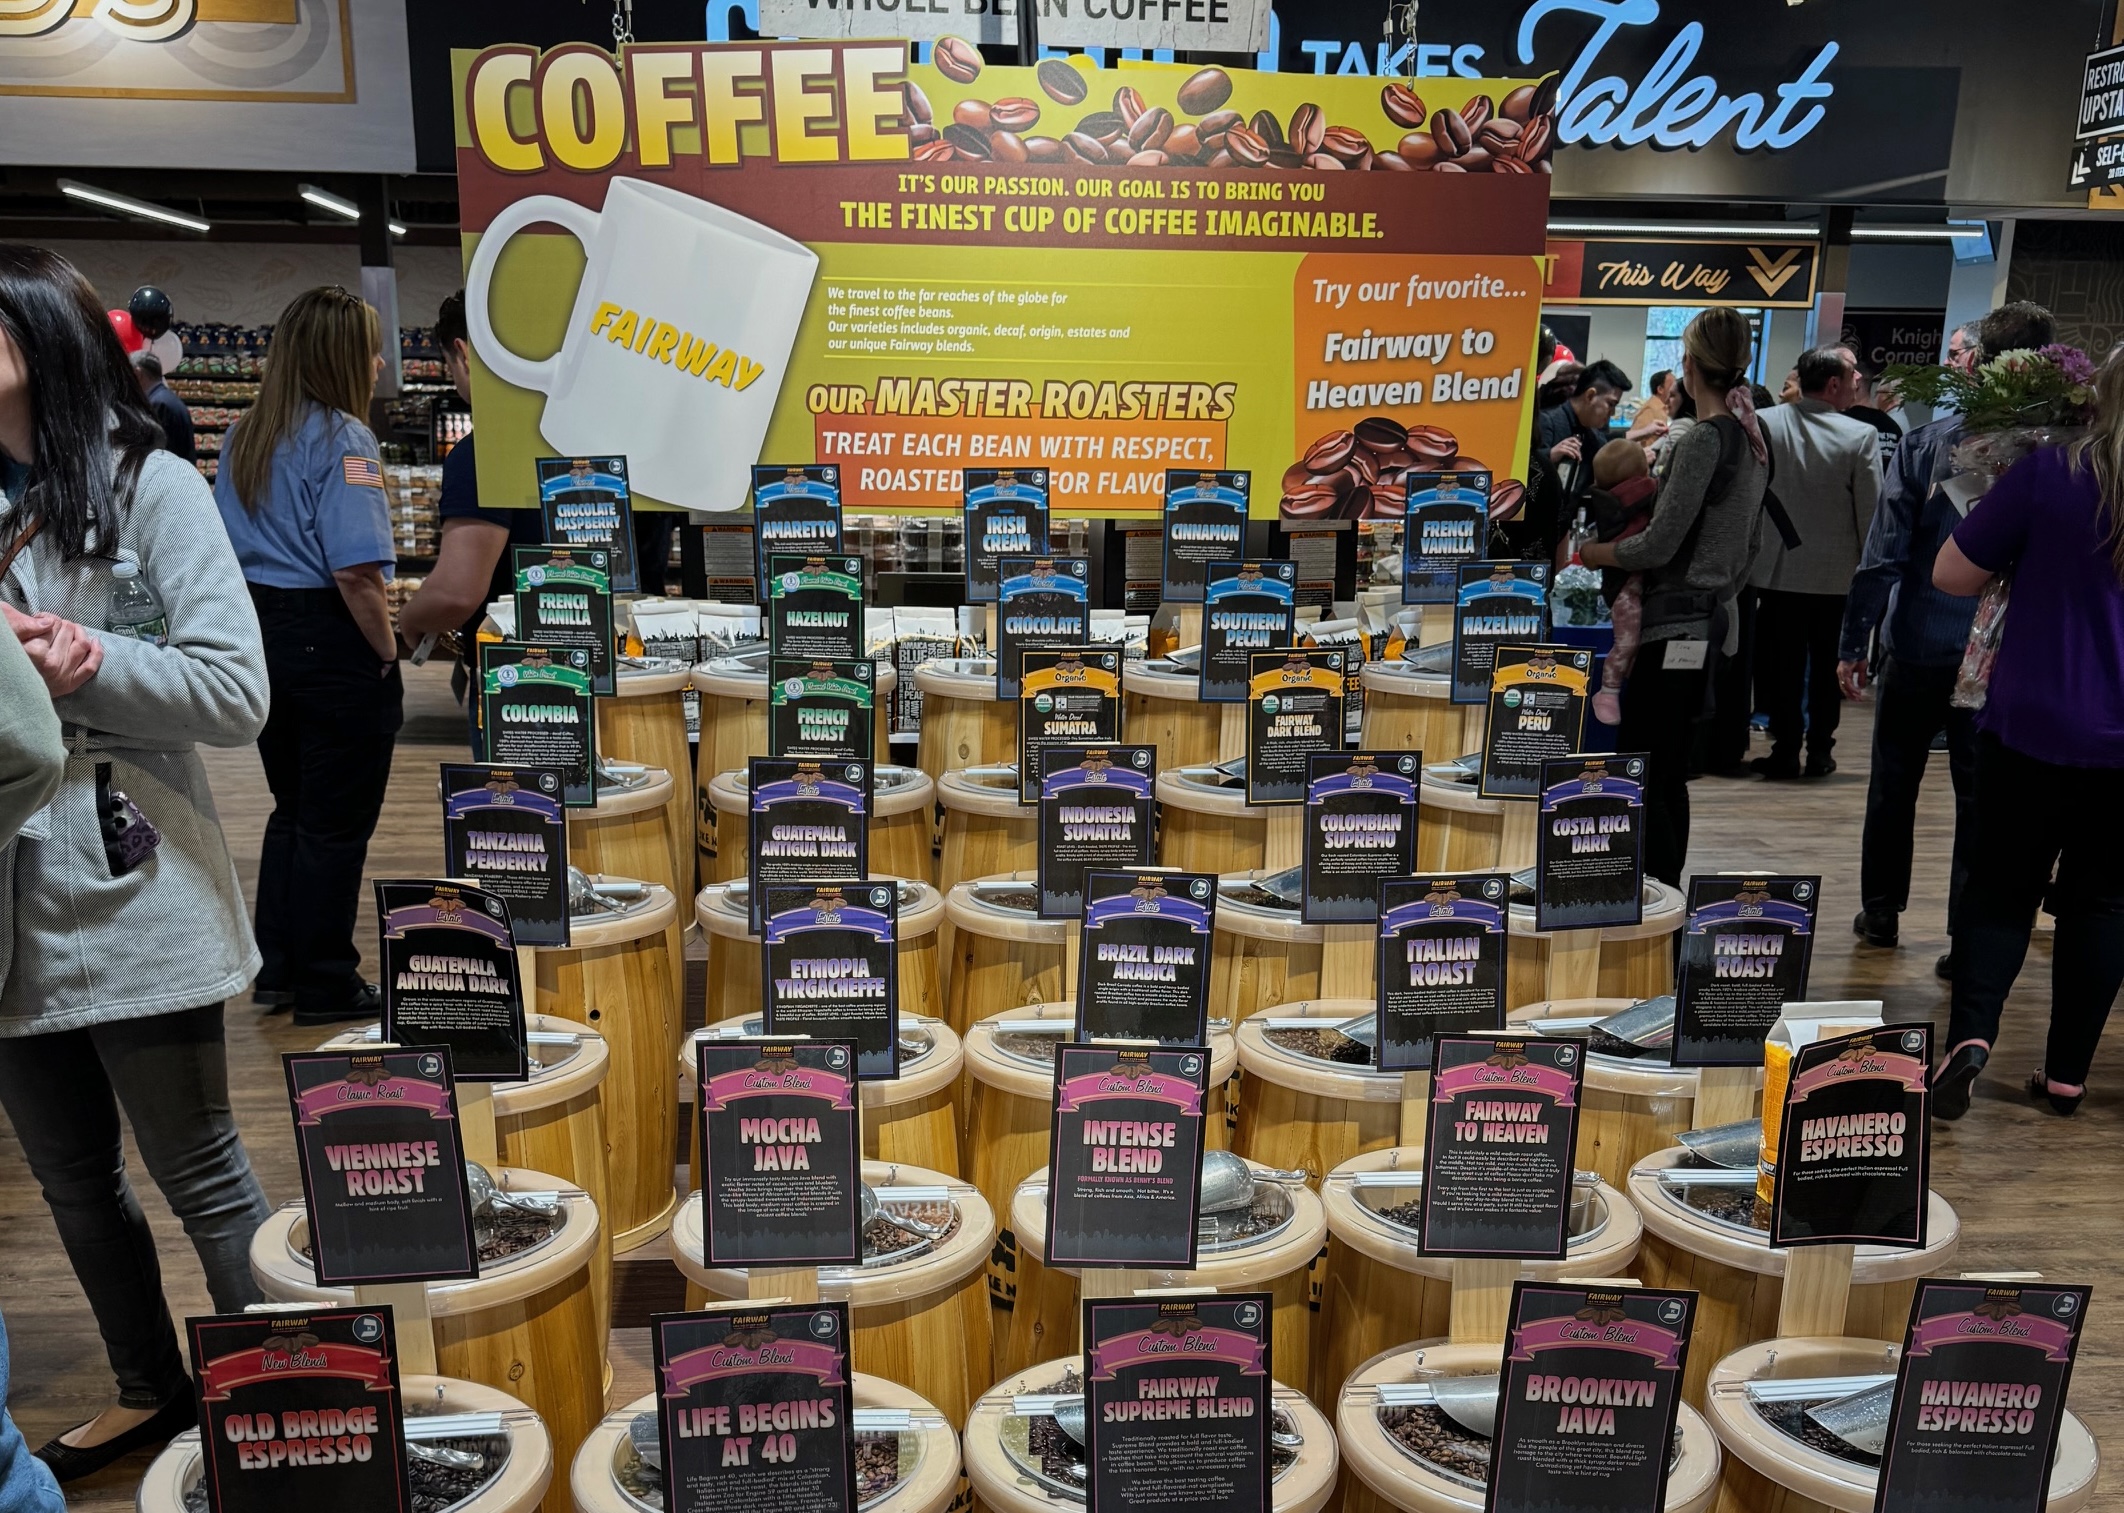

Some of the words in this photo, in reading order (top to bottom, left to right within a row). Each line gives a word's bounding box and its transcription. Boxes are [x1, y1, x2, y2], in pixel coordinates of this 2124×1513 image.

[1301, 40, 1485, 79] TAKES
[1517, 0, 1839, 149] Talent
[473, 47, 910, 171] COFFEE
[899, 174, 935, 193] IT'S
[941, 175, 978, 194] OUR
[985, 177, 1069, 196] PASSION.
[1075, 179, 1112, 197] OUR
[1118, 180, 1165, 199] GOAL
[1170, 181, 1190, 199] IS
[1196, 181, 1219, 200] TO
[1225, 182, 1282, 201] BRING
[1288, 183, 1325, 202] YOU
[840, 201, 892, 228] THE
[901, 203, 996, 230] FINEST
[1004, 205, 1054, 232] CUP
[1063, 207, 1096, 233] OF
[1104, 207, 1197, 236] COFFEE
[1205, 210, 1385, 239] IMAGINABLE.
[1598, 260, 1655, 290] This
[1660, 262, 1732, 294] Way
[828, 287, 844, 299] We
[848, 288, 880, 299] travel
[884, 289, 895, 299] to
[898, 289, 916, 300] the
[918, 289, 936, 303] far
[938, 290, 980, 302] reaches
[983, 291, 995, 305] of
[997, 291, 1015, 303] the
[1018, 292, 1048, 306] globe
[1051, 292, 1068, 306] for
[1313, 279, 1351, 309] Try
[1358, 282, 1400, 302] our
[1406, 274, 1527, 307] favorite...
[828, 304, 846, 315] the
[849, 304, 879, 318] finest
[882, 306, 916, 319] coffee
[919, 306, 954, 318] beans.
[828, 321, 848, 332] Our
[851, 322, 898, 333] varieties
[901, 323, 944, 334] includes
[947, 325, 990, 338] organic,
[994, 325, 1026, 339] decaf,
[1029, 325, 1064, 339] origin,
[1067, 327, 1106, 337] estates
[1109, 327, 1130, 338] and
[590, 301, 765, 392] FAIRWAY
[828, 339, 847, 349] our
[850, 339, 887, 352] unique
[890, 339, 933, 353] Fairway
[936, 340, 974, 352] blends.
[1324, 329, 1452, 364] Fairway
[1461, 328, 1494, 355] to
[1871, 347, 1934, 363] Corner
[807, 384, 868, 415] OUR
[874, 377, 1033, 418] MASTER
[1041, 379, 1238, 421] ROASTERS
[1306, 380, 1423, 409] Heaven
[1431, 368, 1522, 402] Blend
[823, 431, 893, 455] TREAT
[902, 432, 960, 457] EACH
[969, 435, 1030, 458] BEAN
[1040, 436, 1100, 459] WITH
[1111, 437, 1215, 463] RESPECT,
[860, 468, 963, 492] ROASTED
[1050, 472, 1089, 494] FOR
[557, 503, 616, 517] CHOCOLATE
[555, 516, 621, 530] RASPBERRY
[762, 520, 837, 538] AMARETTO
[986, 516, 1027, 534] IRISH
[1171, 523, 1239, 541] CINNAMON
[566, 529, 612, 542] TRUFFLE
[982, 533, 1031, 552] CREAM
[538, 593, 588, 609] FRENCH
[538, 609, 591, 625] VANILLA
[786, 611, 849, 628] HAZELNUT
[1006, 617, 1082, 635] CHOCOLATE
[1211, 612, 1286, 630] SOUTHERN
[1226, 630, 1270, 647] PECAN
[1055, 672, 1087, 683] Organic
[1282, 672, 1312, 683] Organic
[1526, 668, 1557, 680] Organic
[501, 704, 579, 723] COLOMBIA
[1275, 714, 1314, 726] FAIRWAY
[1518, 716, 1551, 731] PERU
[1044, 721, 1097, 735] SUMATRA
[1267, 726, 1292, 738] DARK
[1293, 725, 1322, 736] BLEND
[1059, 806, 1136, 824] INDONESIA
[1320, 814, 1402, 832] COLOMBIAN
[1553, 817, 1595, 836] COSTA
[1599, 815, 1631, 834] RICA
[467, 831, 546, 852] TANZANIA
[772, 825, 846, 842] GUATEMALA
[1064, 824, 1131, 841] SUMATRA
[1325, 831, 1396, 849] SUPREMO
[761, 841, 818, 857] ANTIGUA
[821, 842, 857, 858] DARK
[1571, 834, 1611, 854] DARK
[466, 851, 549, 872] PEABERRY
[1098, 943, 1150, 962] BRAZIL
[1153, 946, 1195, 965] DARK
[1407, 937, 1480, 963] ITALIAN
[1714, 934, 1784, 956] FRENCH
[790, 958, 870, 979] ETHIOPIA
[1113, 962, 1177, 982] ARABICA
[1410, 961, 1477, 986] ROAST
[1715, 956, 1778, 978] ROAST
[775, 978, 886, 999] YIRGACHEFFE
[1465, 1100, 1542, 1122] FAIRWAY
[740, 1117, 822, 1144] MOCHA
[1083, 1120, 1176, 1147] INTENSE
[1455, 1122, 1477, 1142] TO
[1482, 1124, 1549, 1144] HEAVEN
[1801, 1112, 1906, 1141] HAVANERO
[324, 1141, 441, 1171] VIENNESE
[753, 1146, 810, 1172] JAVA
[1800, 1135, 1903, 1162] ESPRESSO
[1092, 1148, 1163, 1174] BLEND
[345, 1168, 426, 1197] ROAST
[1160, 1303, 1195, 1311] FAIRWAY
[271, 1318, 309, 1327] FAIRWAY
[1558, 1322, 1599, 1341] Custom
[1603, 1327, 1638, 1344] Blend
[262, 1355, 288, 1370] New
[290, 1352, 327, 1369] Blends
[1138, 1376, 1220, 1399] FAIRWAY
[1525, 1374, 1657, 1408] BROOKLYN
[1919, 1380, 2042, 1410] HAVANERO
[678, 1405, 731, 1438] LIFE
[738, 1398, 836, 1434] BEGINS
[1103, 1399, 1191, 1423] SUPREME
[1197, 1397, 1254, 1419] BLEND
[1556, 1406, 1616, 1435] JAVA
[1917, 1406, 2035, 1435] ESPRESSO
[224, 1412, 276, 1443] OLD
[282, 1406, 379, 1439] BRIDGE
[238, 1434, 372, 1470] ESPRESSO
[721, 1437, 752, 1467] AT
[761, 1433, 797, 1464] 40
